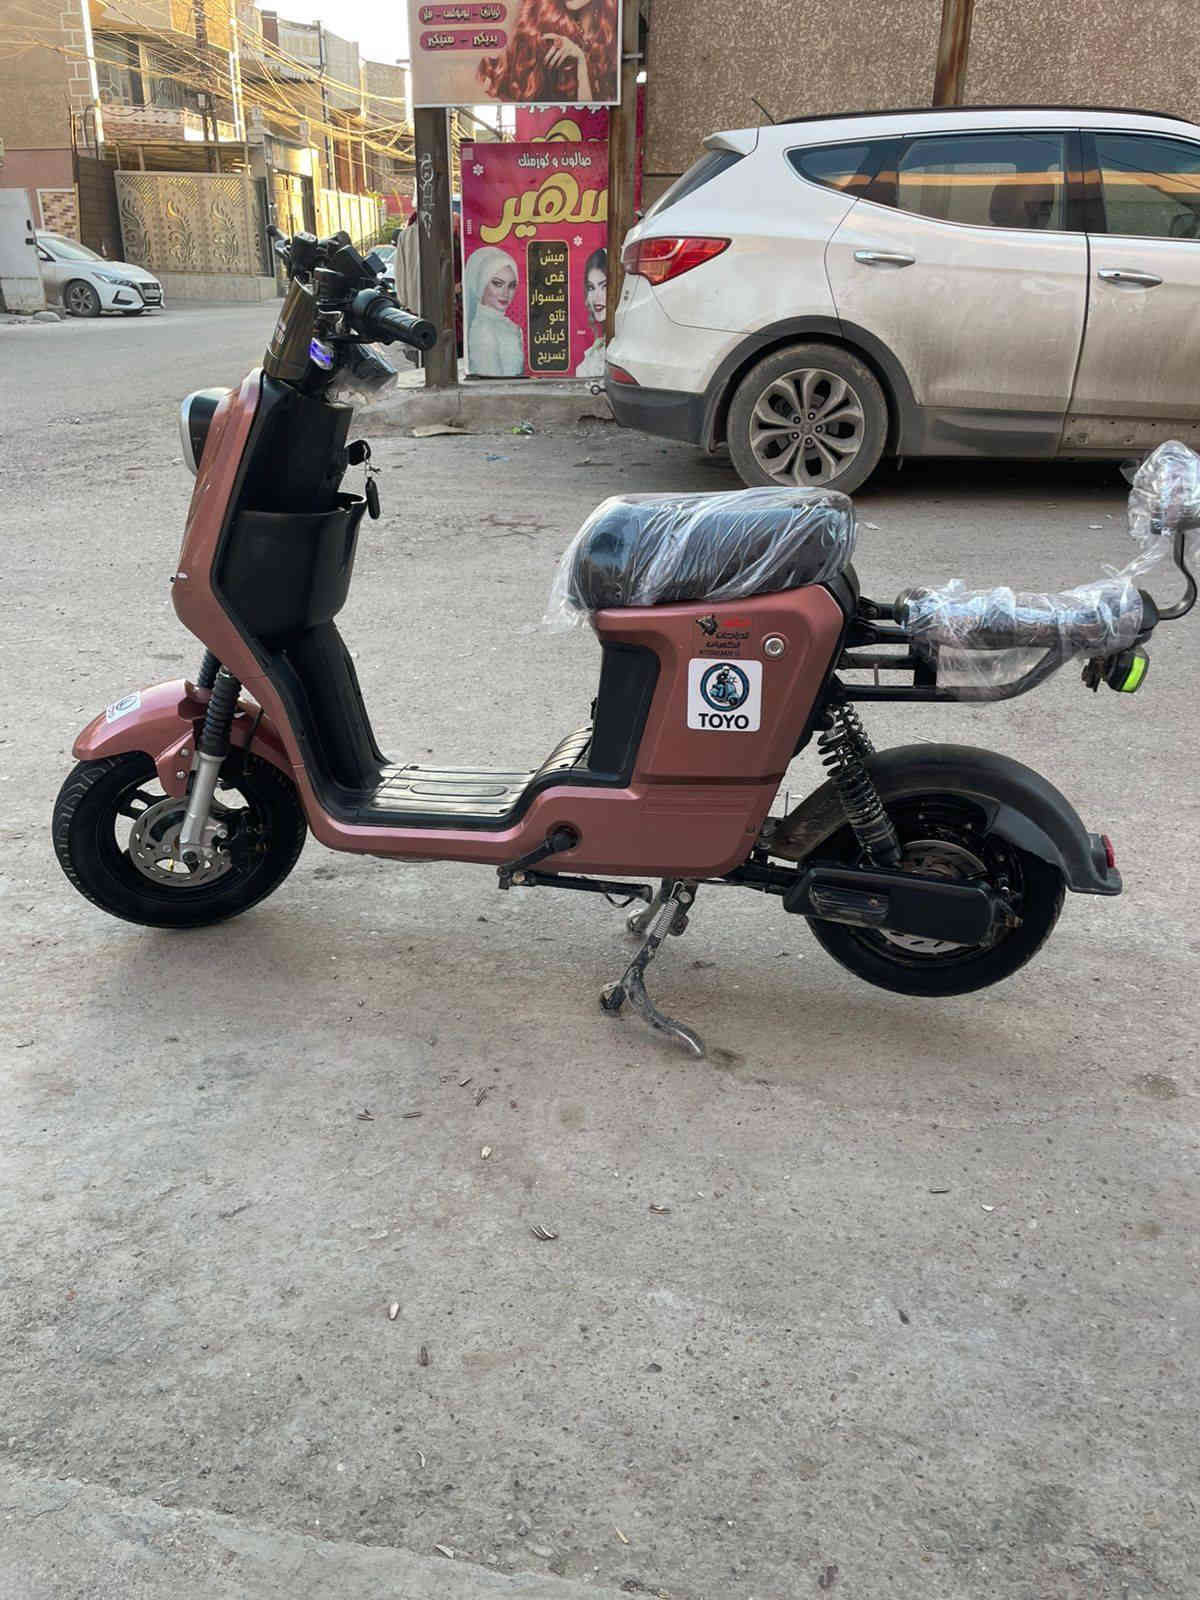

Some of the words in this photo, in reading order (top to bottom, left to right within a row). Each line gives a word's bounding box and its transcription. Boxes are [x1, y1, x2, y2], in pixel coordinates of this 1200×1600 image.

[552, 159, 559, 168] و
[560, 151, 592, 168] صالون
[540, 249, 565, 265] ميش
[545, 271, 565, 285] قص
[531, 288, 565, 305] شسوار
[548, 309, 566, 325] تاتو
[537, 348, 566, 365] تسريح
[698, 713, 749, 729] TOYO
